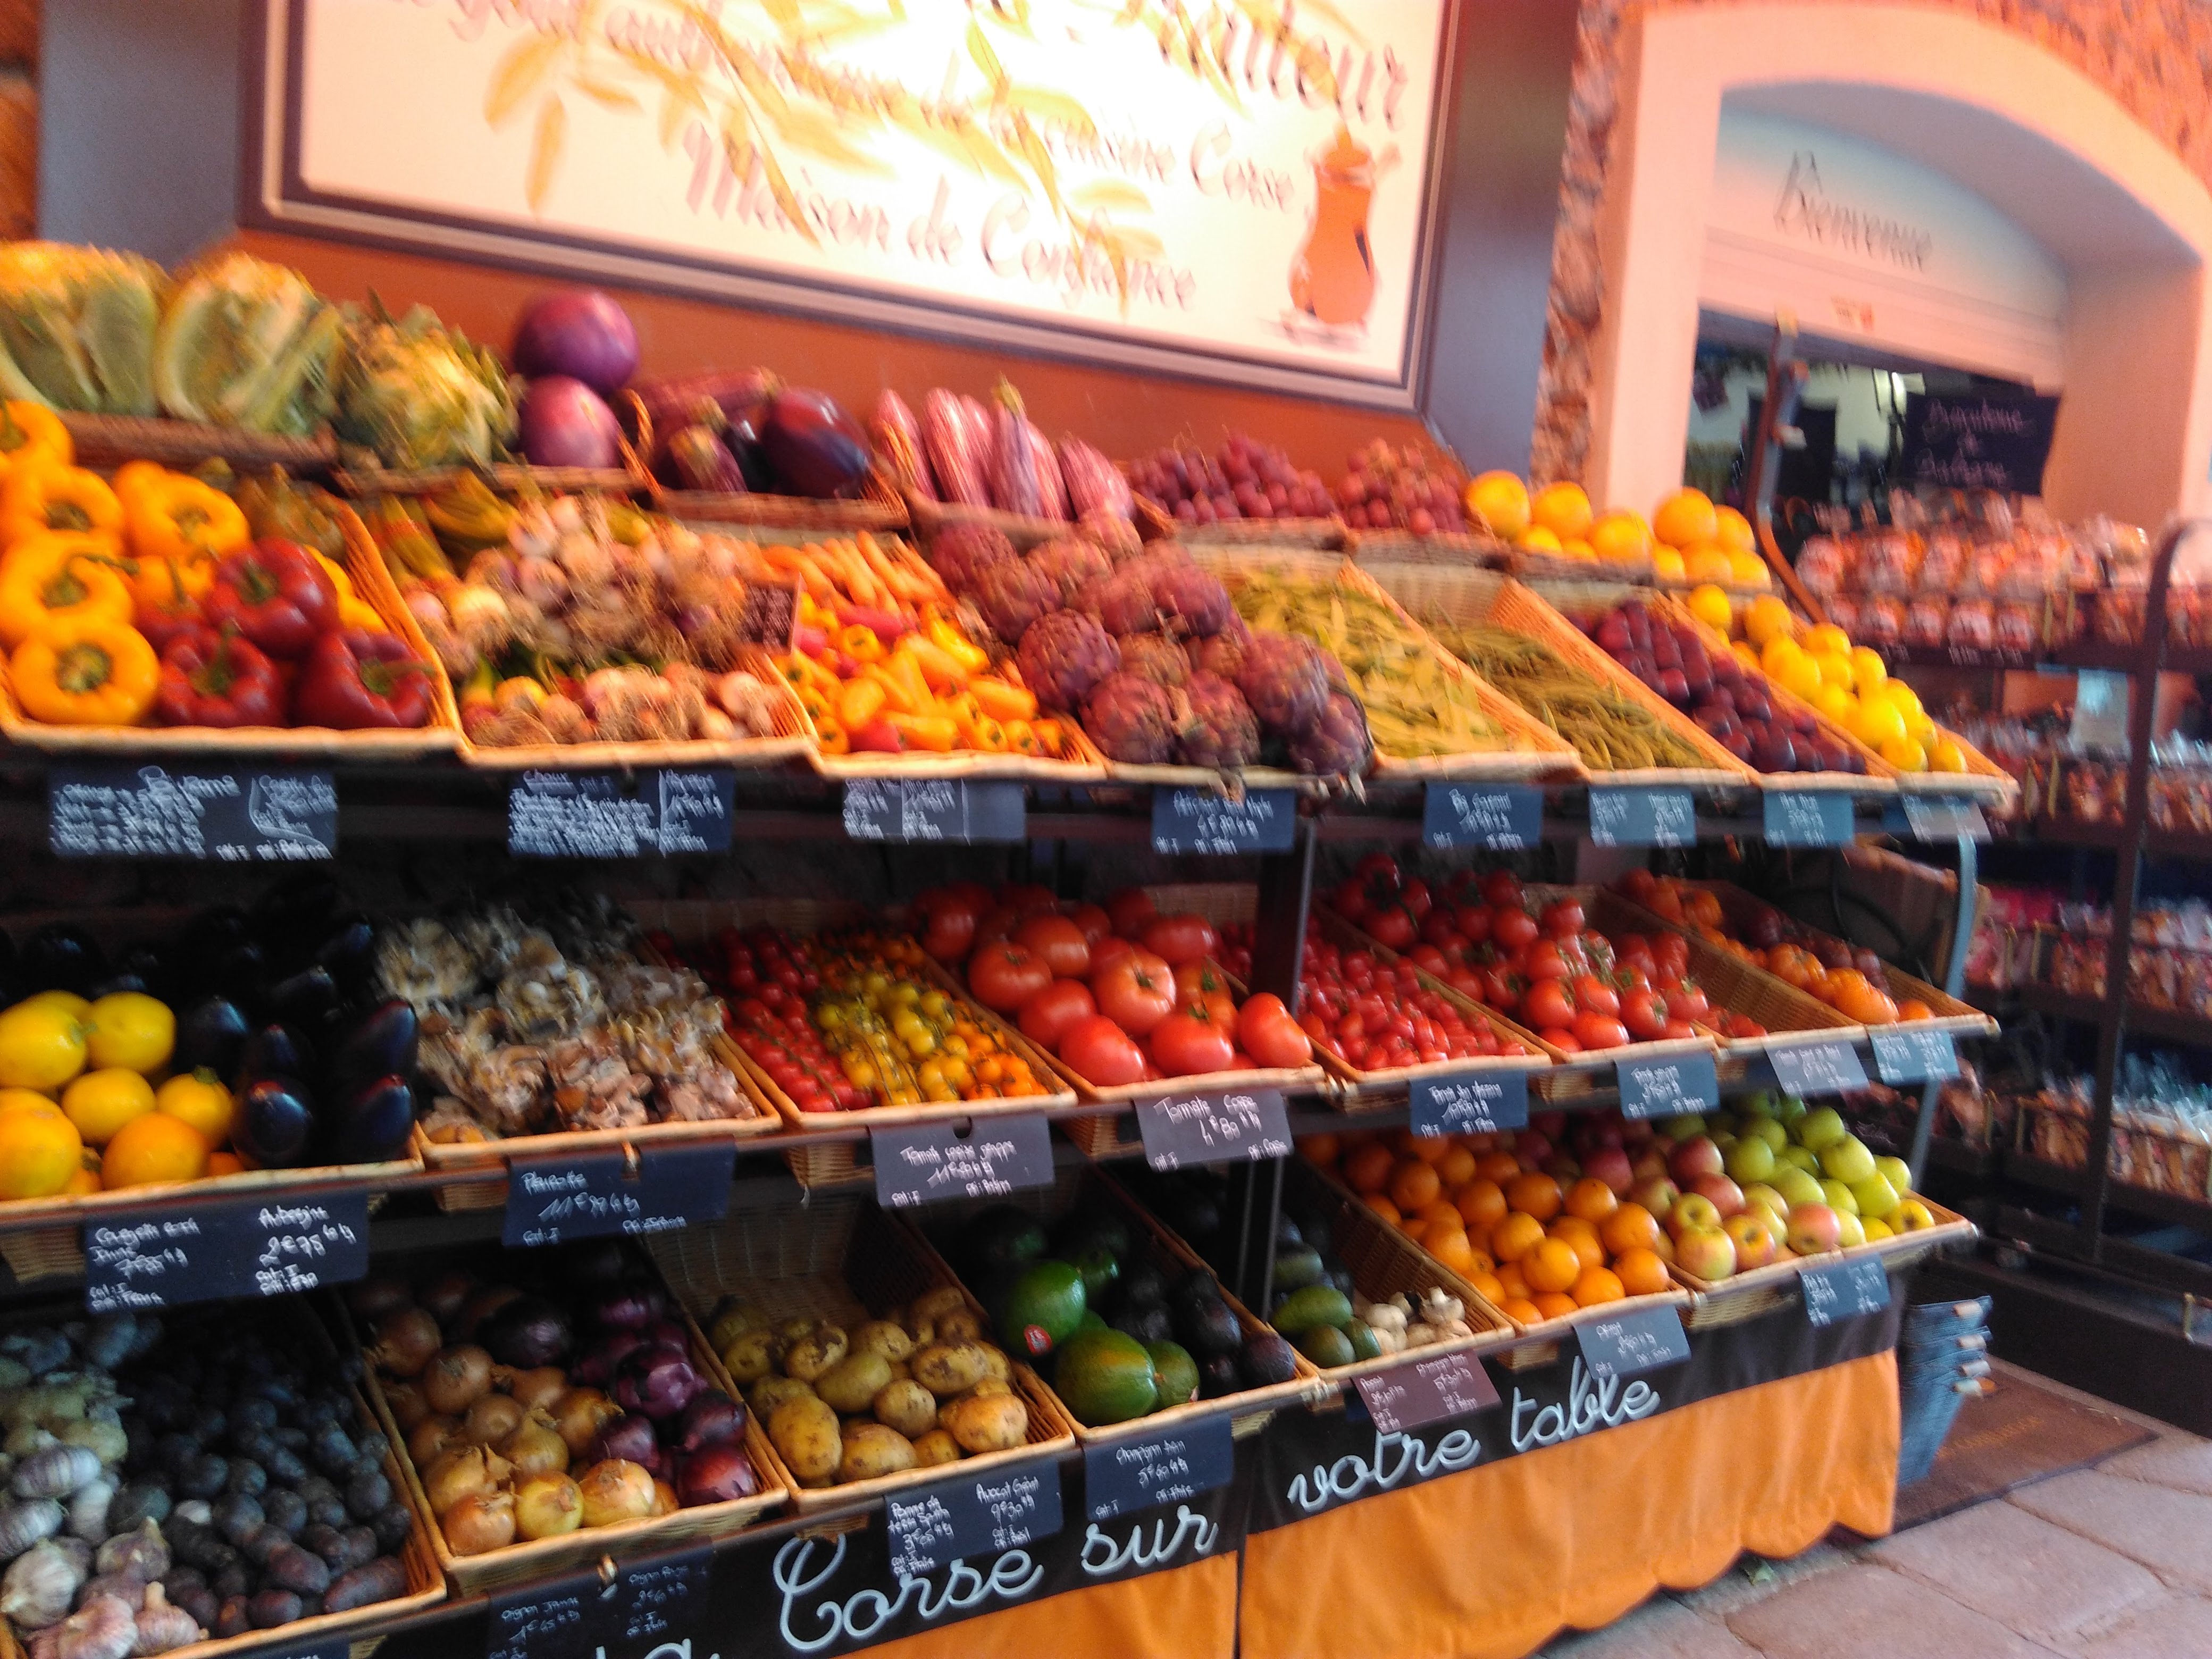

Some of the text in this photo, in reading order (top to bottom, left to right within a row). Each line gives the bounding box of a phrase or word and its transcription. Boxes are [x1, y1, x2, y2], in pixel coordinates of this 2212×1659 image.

[681, 118, 890, 252] Maison
[906, 174, 963, 266] de
[1153, 1095, 1213, 1124] Tomate
[1287, 1354, 1662, 1513] votre table
[772, 1505, 1218, 1653] Corse sur
